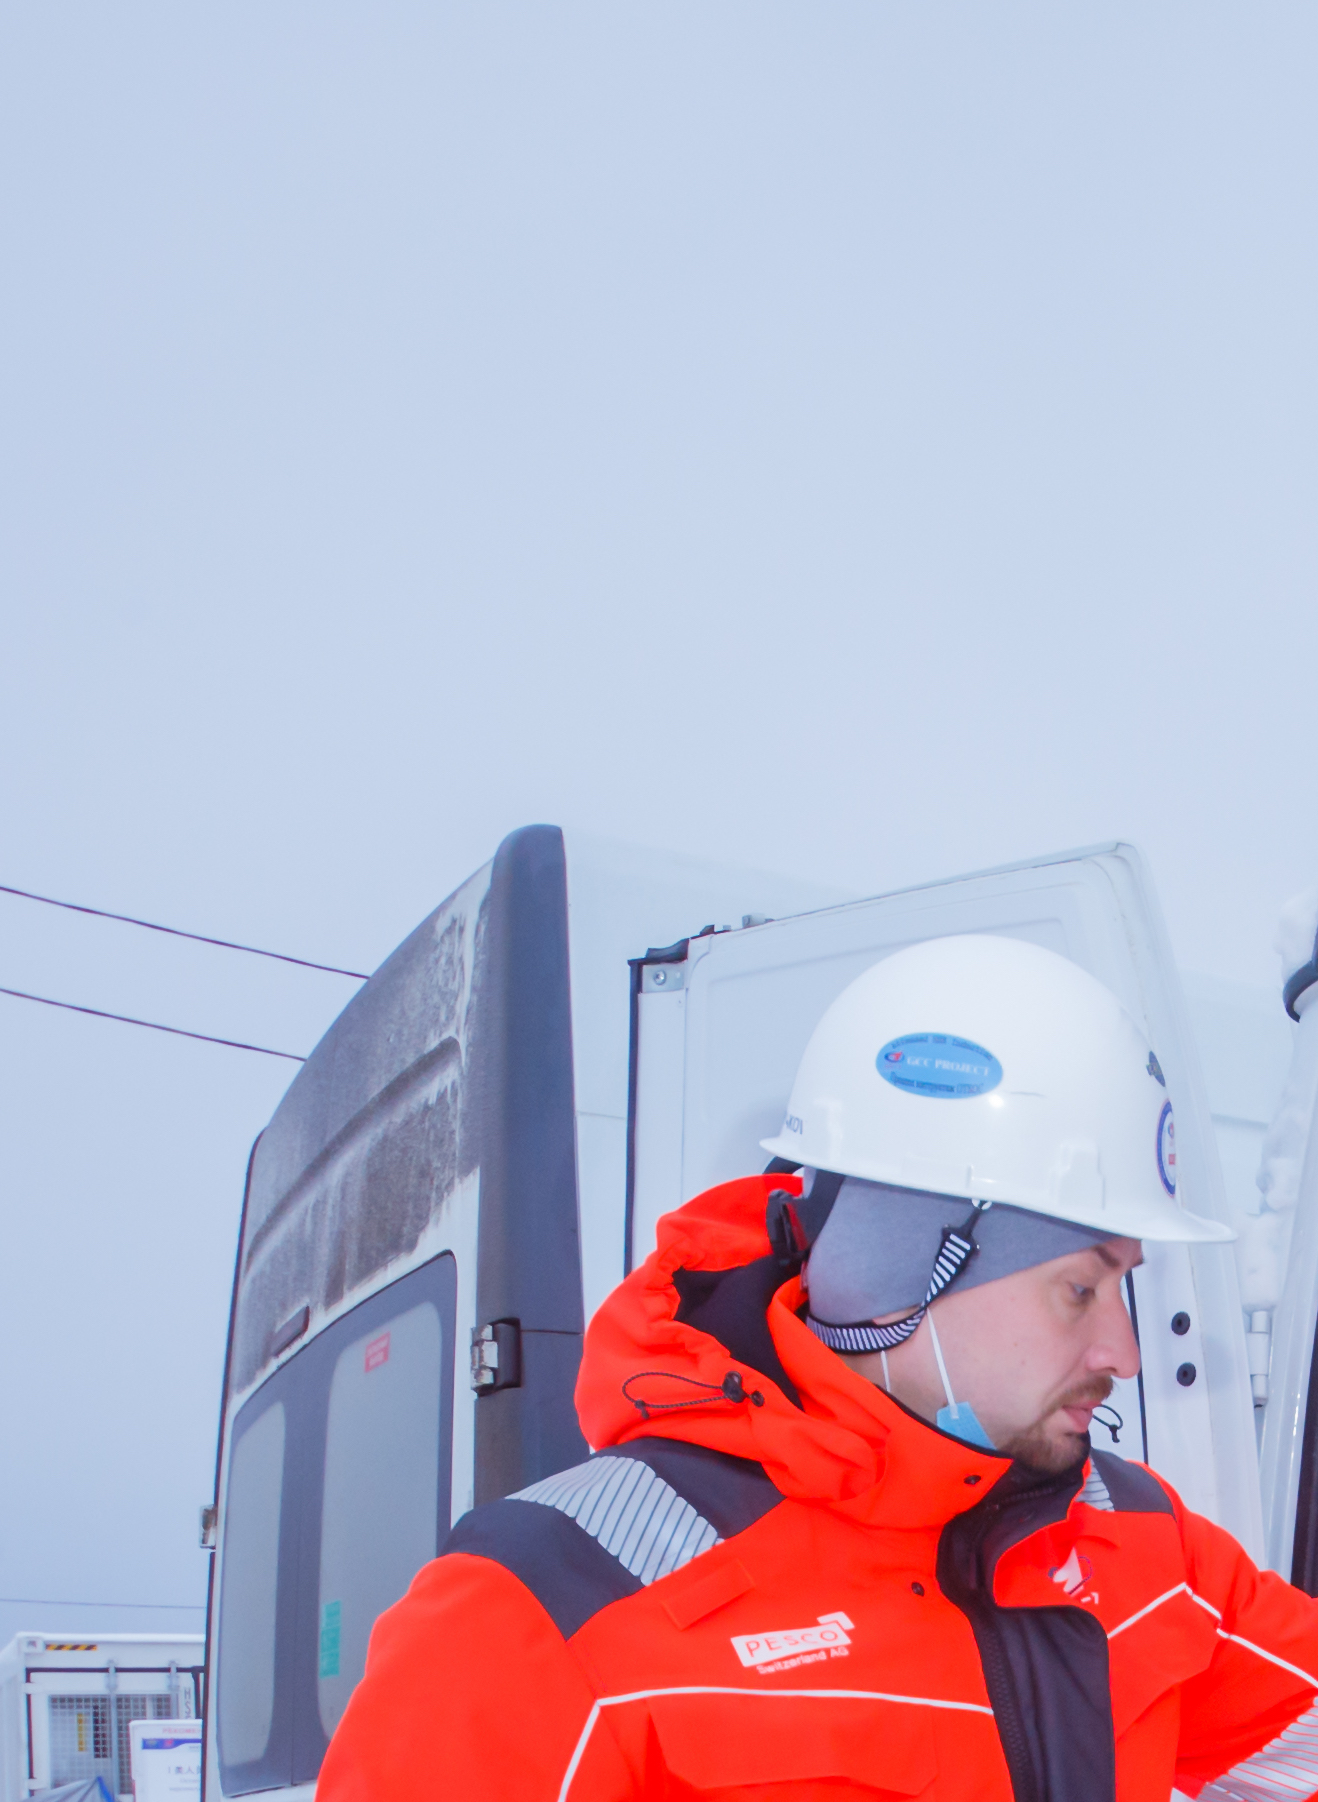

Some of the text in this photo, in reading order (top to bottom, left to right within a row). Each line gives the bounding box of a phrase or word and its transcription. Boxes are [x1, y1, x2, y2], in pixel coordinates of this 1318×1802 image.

[935, 1058, 989, 1077] PROJECT
[745, 1629, 839, 1658] PESCO
[756, 1645, 849, 1675] Switzerland AG
